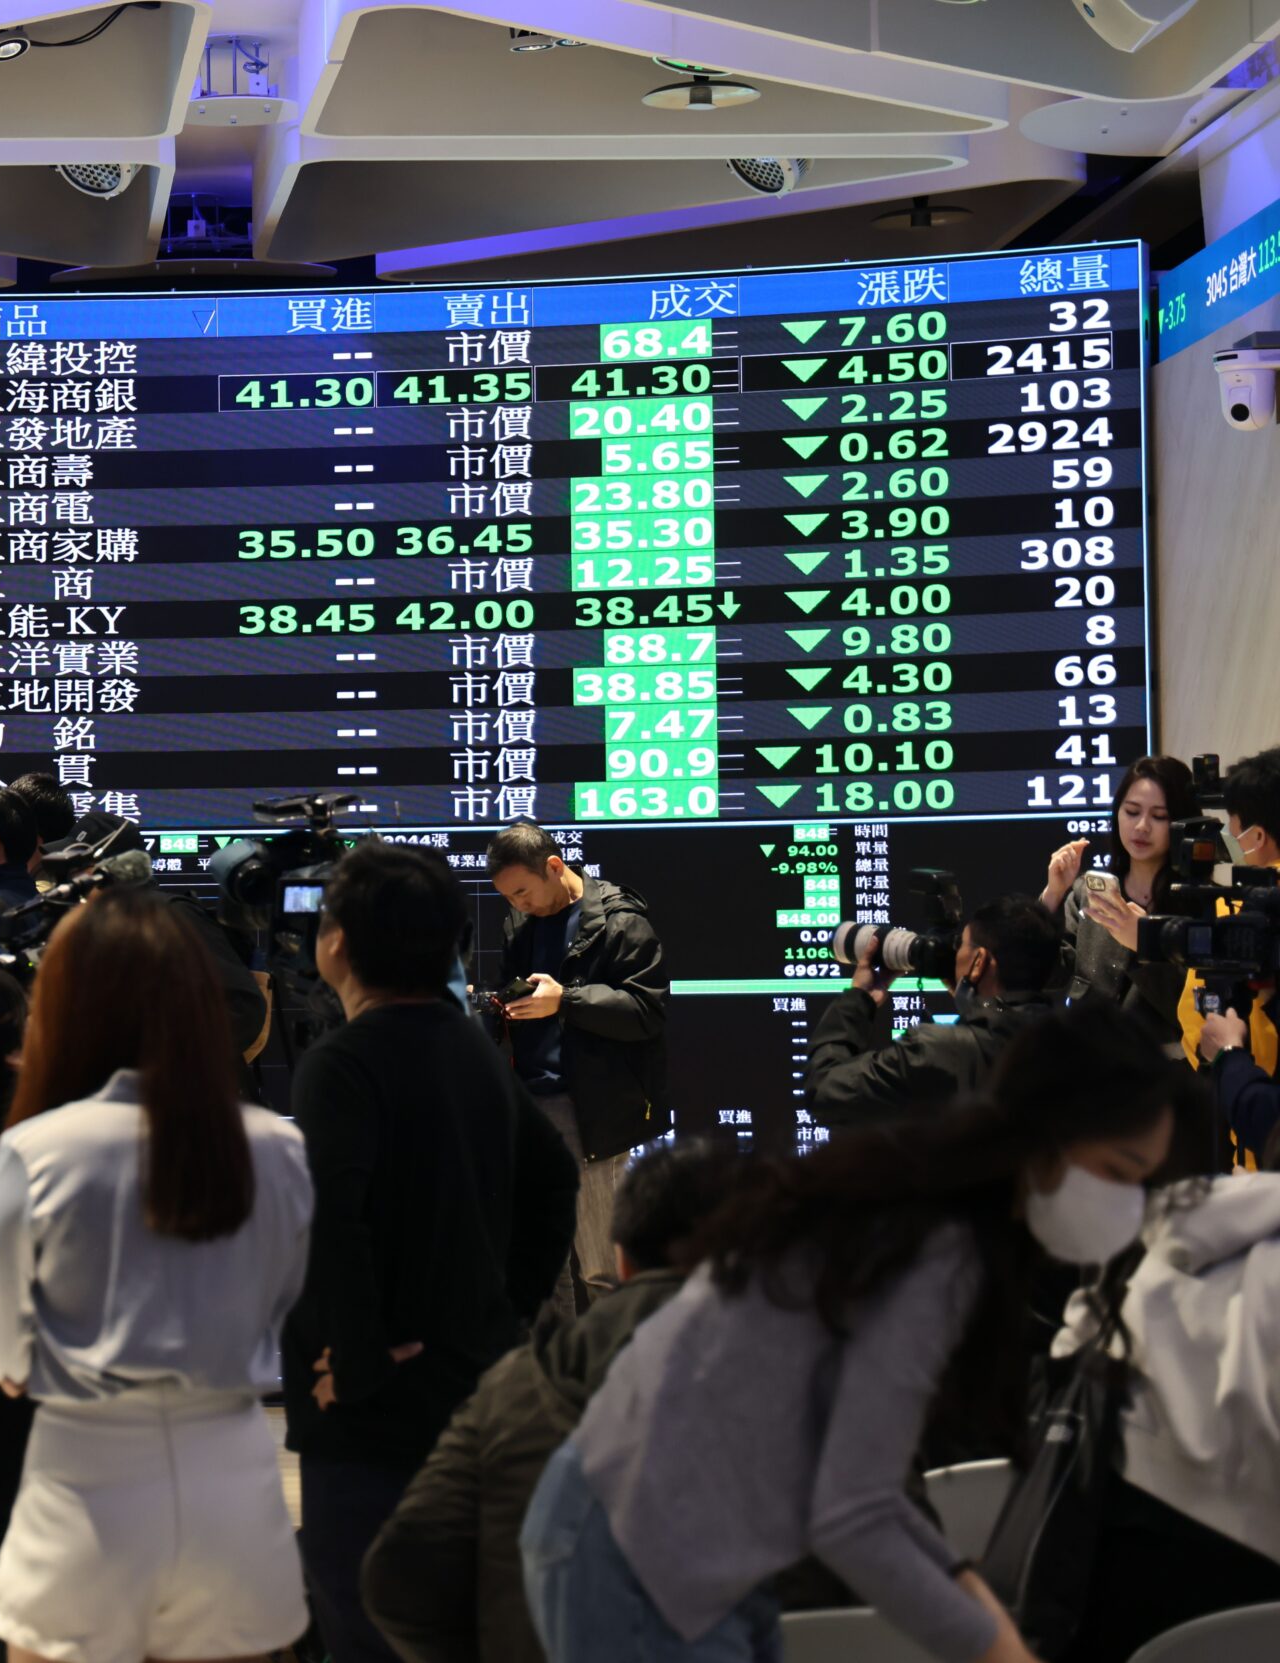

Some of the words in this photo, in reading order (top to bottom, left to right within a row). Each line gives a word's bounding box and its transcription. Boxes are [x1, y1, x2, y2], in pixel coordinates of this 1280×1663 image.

[287, 298, 372, 333] 買進
[444, 292, 529, 328] 賣出
[650, 282, 736, 319] 成交
[858, 268, 946, 305] 漲跌
[1020, 255, 1109, 294] 總量
[1206, 266, 1228, 307] 3045
[446, 330, 532, 367] 市價
[604, 326, 711, 359] 68.4
[839, 311, 946, 345] 7.60
[1050, 299, 1110, 332] 32
[236, 377, 375, 408] 41.30
[394, 373, 531, 403] 41.35
[572, 364, 710, 397] 41.30
[839, 350, 947, 384] 4.50
[987, 337, 1111, 374] 2415
[574, 402, 711, 436] 20.40
[841, 389, 947, 423] 2.25
[1021, 378, 1111, 412] 103
[606, 441, 711, 472] 5.65
[840, 428, 948, 462] 0.62
[988, 417, 1112, 453] 2924
[447, 482, 532, 517] 市價
[575, 479, 713, 512] 23.80
[842, 467, 948, 501] 2.60
[1053, 457, 1112, 489] 59
[239, 529, 374, 559] 35.50
[397, 524, 532, 555] 36.45
[575, 518, 712, 550] 35.30
[842, 506, 949, 539] 3.90
[1055, 497, 1113, 528] 10
[577, 556, 712, 588] 12.25
[845, 545, 949, 578] 1.35
[1021, 536, 1114, 570] 308
[240, 604, 375, 634] 38.45
[396, 600, 533, 630] 42.00
[576, 594, 713, 626] 38.45
[842, 584, 950, 616] 4.00
[1055, 576, 1114, 607] 20
[607, 633, 713, 663] 88.7
[843, 623, 951, 656] 9.80
[1086, 615, 1115, 645] 8
[577, 671, 714, 703] 38.85
[843, 662, 951, 693] 4.30
[1055, 655, 1116, 686] 66
[609, 709, 714, 740] 7.47
[844, 701, 952, 733] 0.83
[1059, 694, 1116, 726] 13
[451, 748, 536, 782] 市價
[609, 748, 715, 778] 90.9
[816, 740, 953, 773] 10.10
[1056, 735, 1116, 765] 41
[580, 786, 716, 817] 163.0
[816, 779, 954, 812] 18.00
[1028, 774, 1113, 806] 121
[794, 828, 829, 839] 848
[854, 824, 888, 838] 時間
[1067, 820, 1111, 832] 09:2
[160, 838, 198, 850] 848
[787, 845, 838, 857] 94.00
[855, 841, 888, 854] 單量
[771, 862, 838, 874] -9.98%
[855, 858, 888, 872] 總量
[805, 879, 839, 890] 848
[855, 875, 889, 889] 昨量
[806, 896, 839, 907] 848
[856, 892, 890, 907] 昨收
[777, 913, 840, 925] 848.00
[856, 910, 890, 924] 開盤
[800, 930, 832, 942] 0.0
[784, 964, 840, 976] 69672
[773, 998, 806, 1011] 買進
[719, 1109, 752, 1124] 買進
